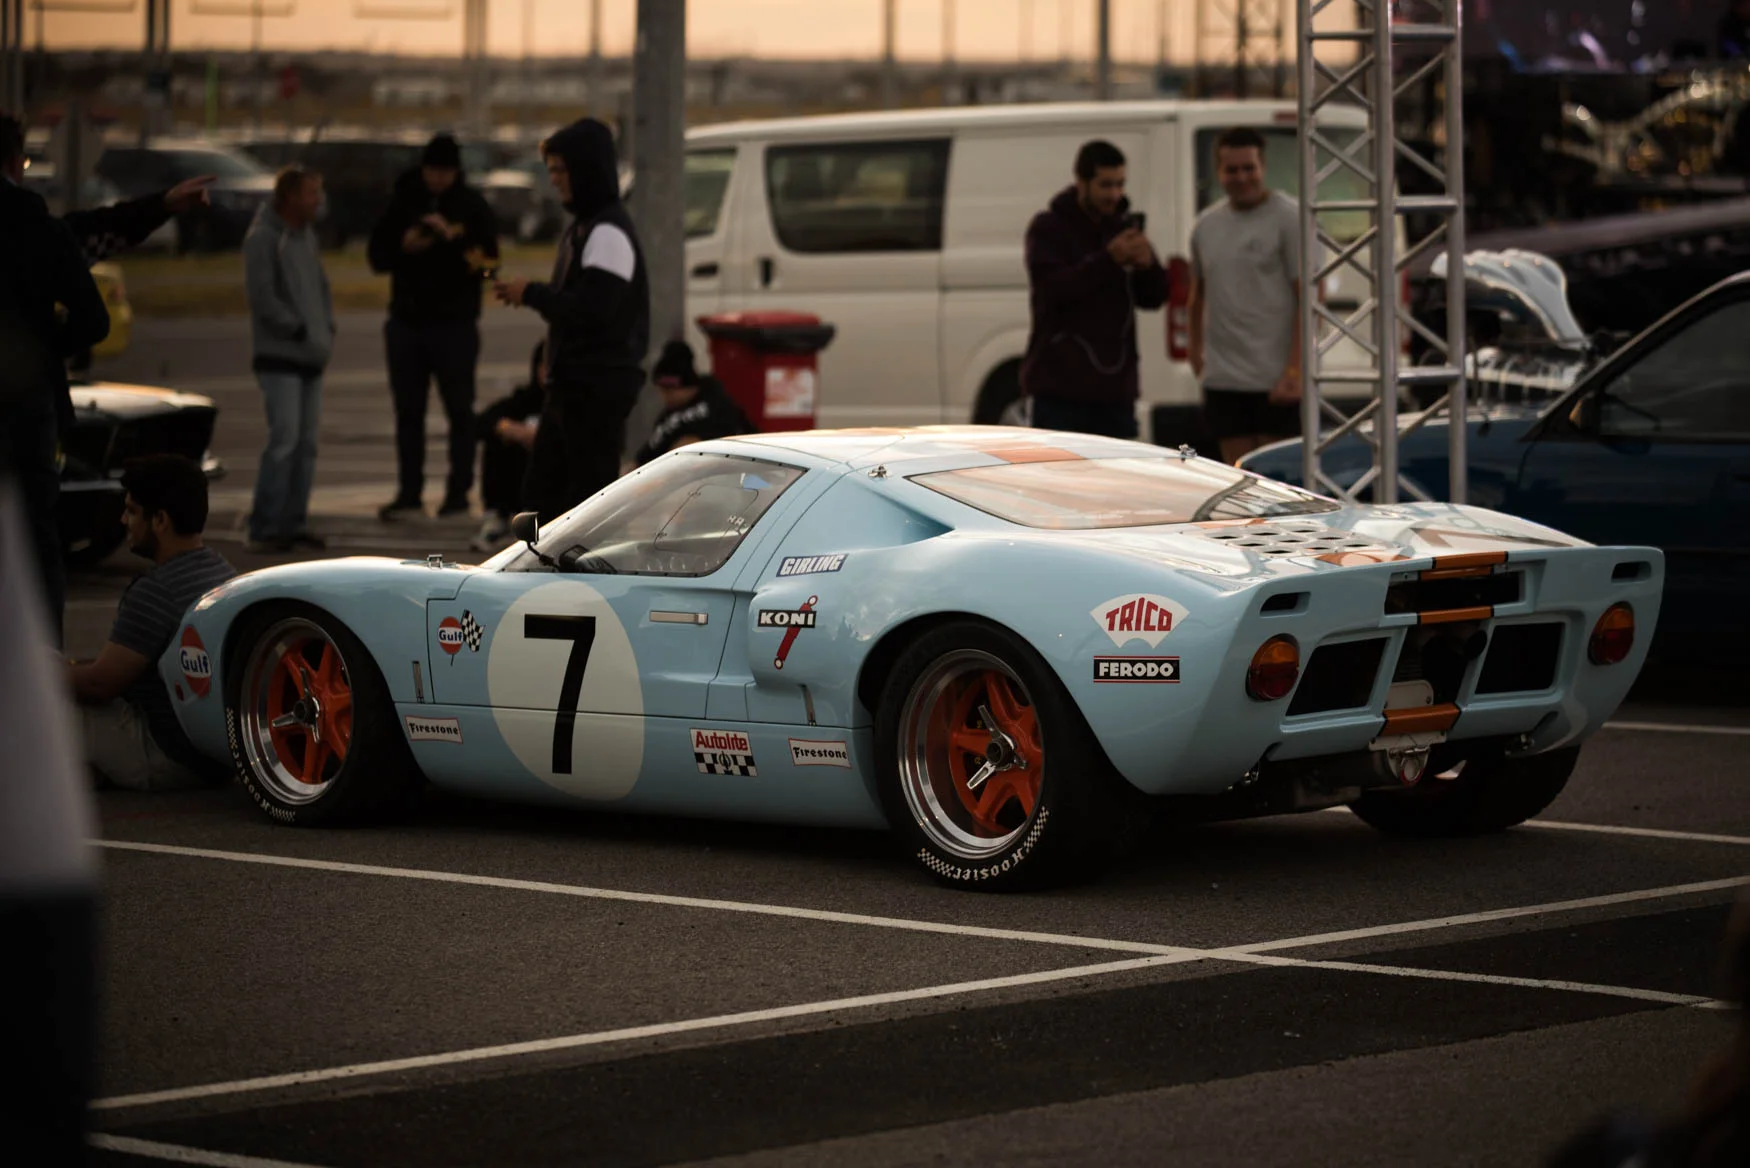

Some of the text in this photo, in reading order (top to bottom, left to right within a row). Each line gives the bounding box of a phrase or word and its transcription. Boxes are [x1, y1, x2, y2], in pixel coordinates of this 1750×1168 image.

[780, 555, 845, 576] GIRLING
[760, 612, 814, 625] KONI
[1105, 597, 1172, 631] TRICO
[439, 629, 463, 641] Gulf
[181, 650, 209, 673] Gulf
[1099, 662, 1174, 677] FERODO
[524, 613, 596, 775] 7
[409, 722, 459, 735] Firestone
[695, 731, 748, 751] Autolite
[793, 746, 848, 760] Firestone
[952, 847, 1026, 881] Hoosier
